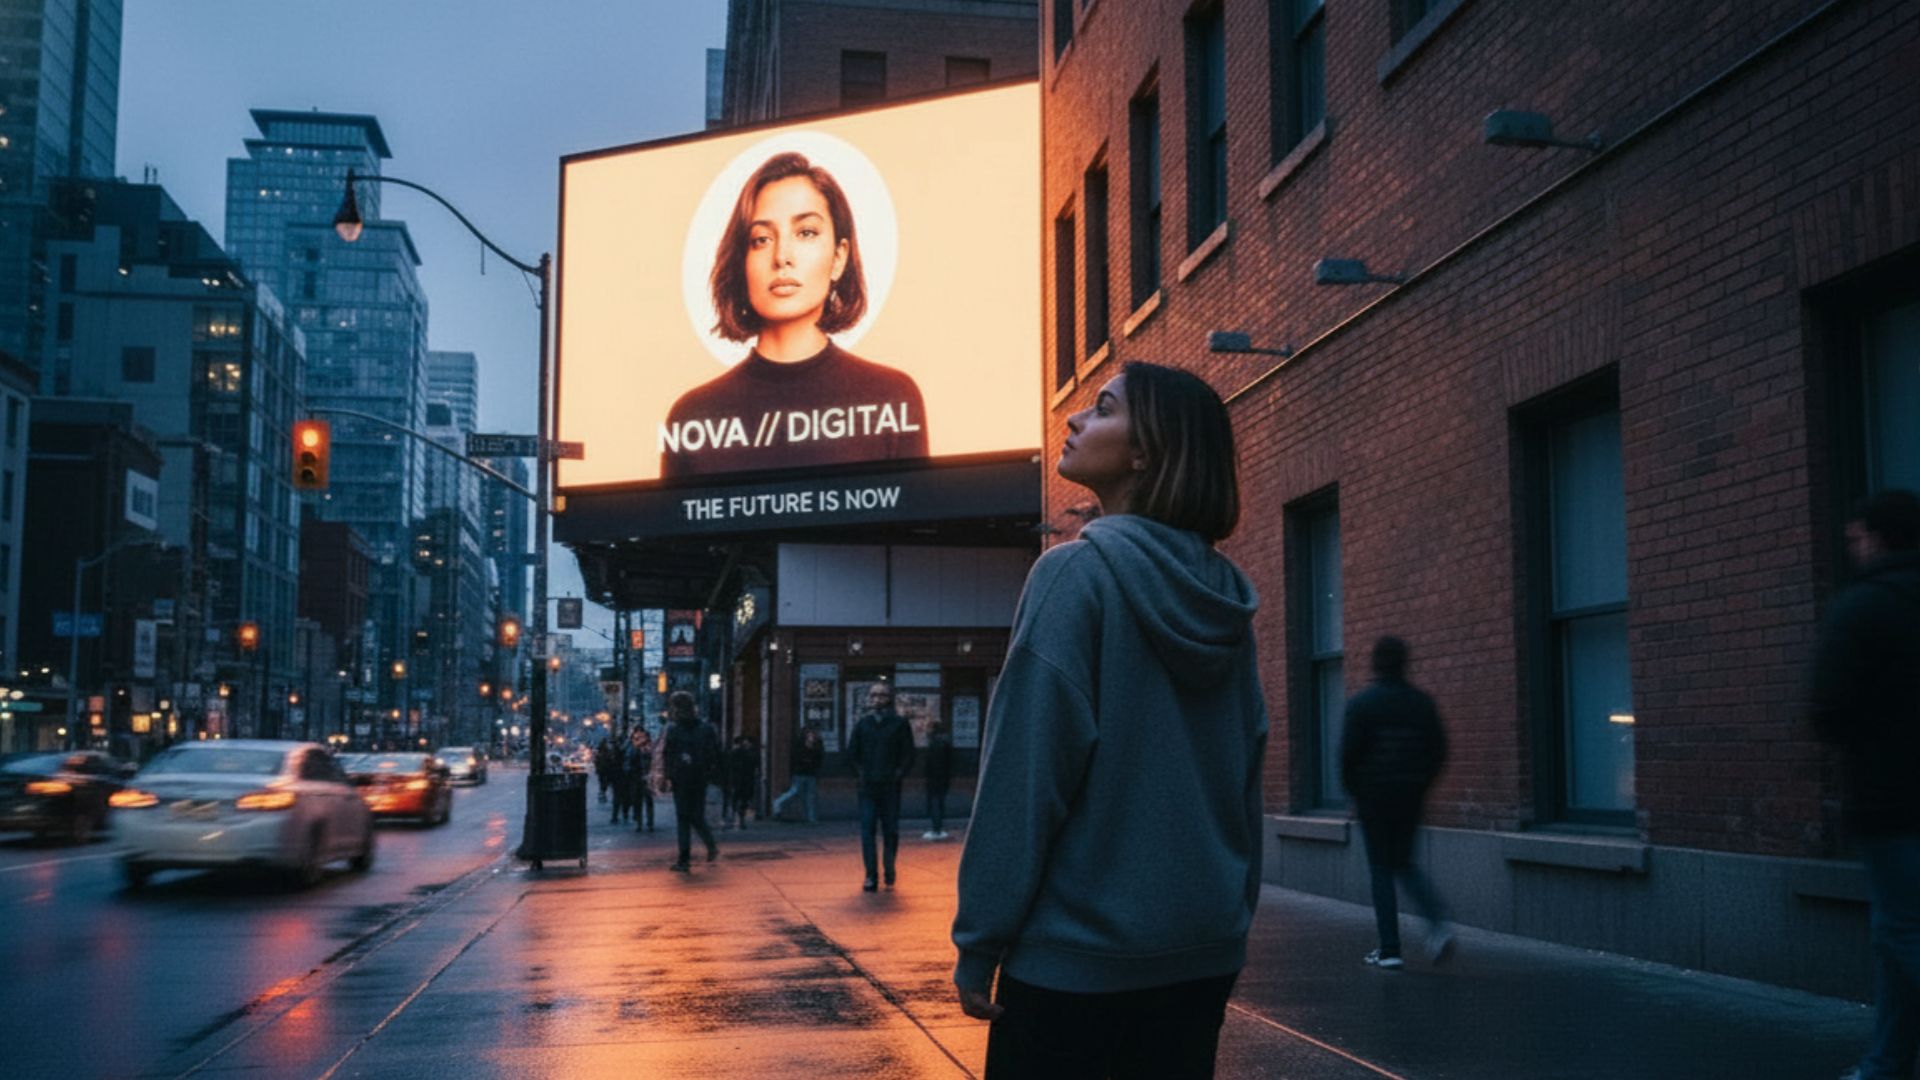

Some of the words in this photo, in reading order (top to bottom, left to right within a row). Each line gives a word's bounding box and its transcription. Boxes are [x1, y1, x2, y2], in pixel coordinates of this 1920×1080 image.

[657, 417, 749, 453] NOVA
[787, 402, 920, 442] DIGITAL
[682, 498, 724, 520] THE
[729, 491, 813, 517] FUTURE
[819, 490, 839, 511] IS
[845, 486, 901, 510] NOW
